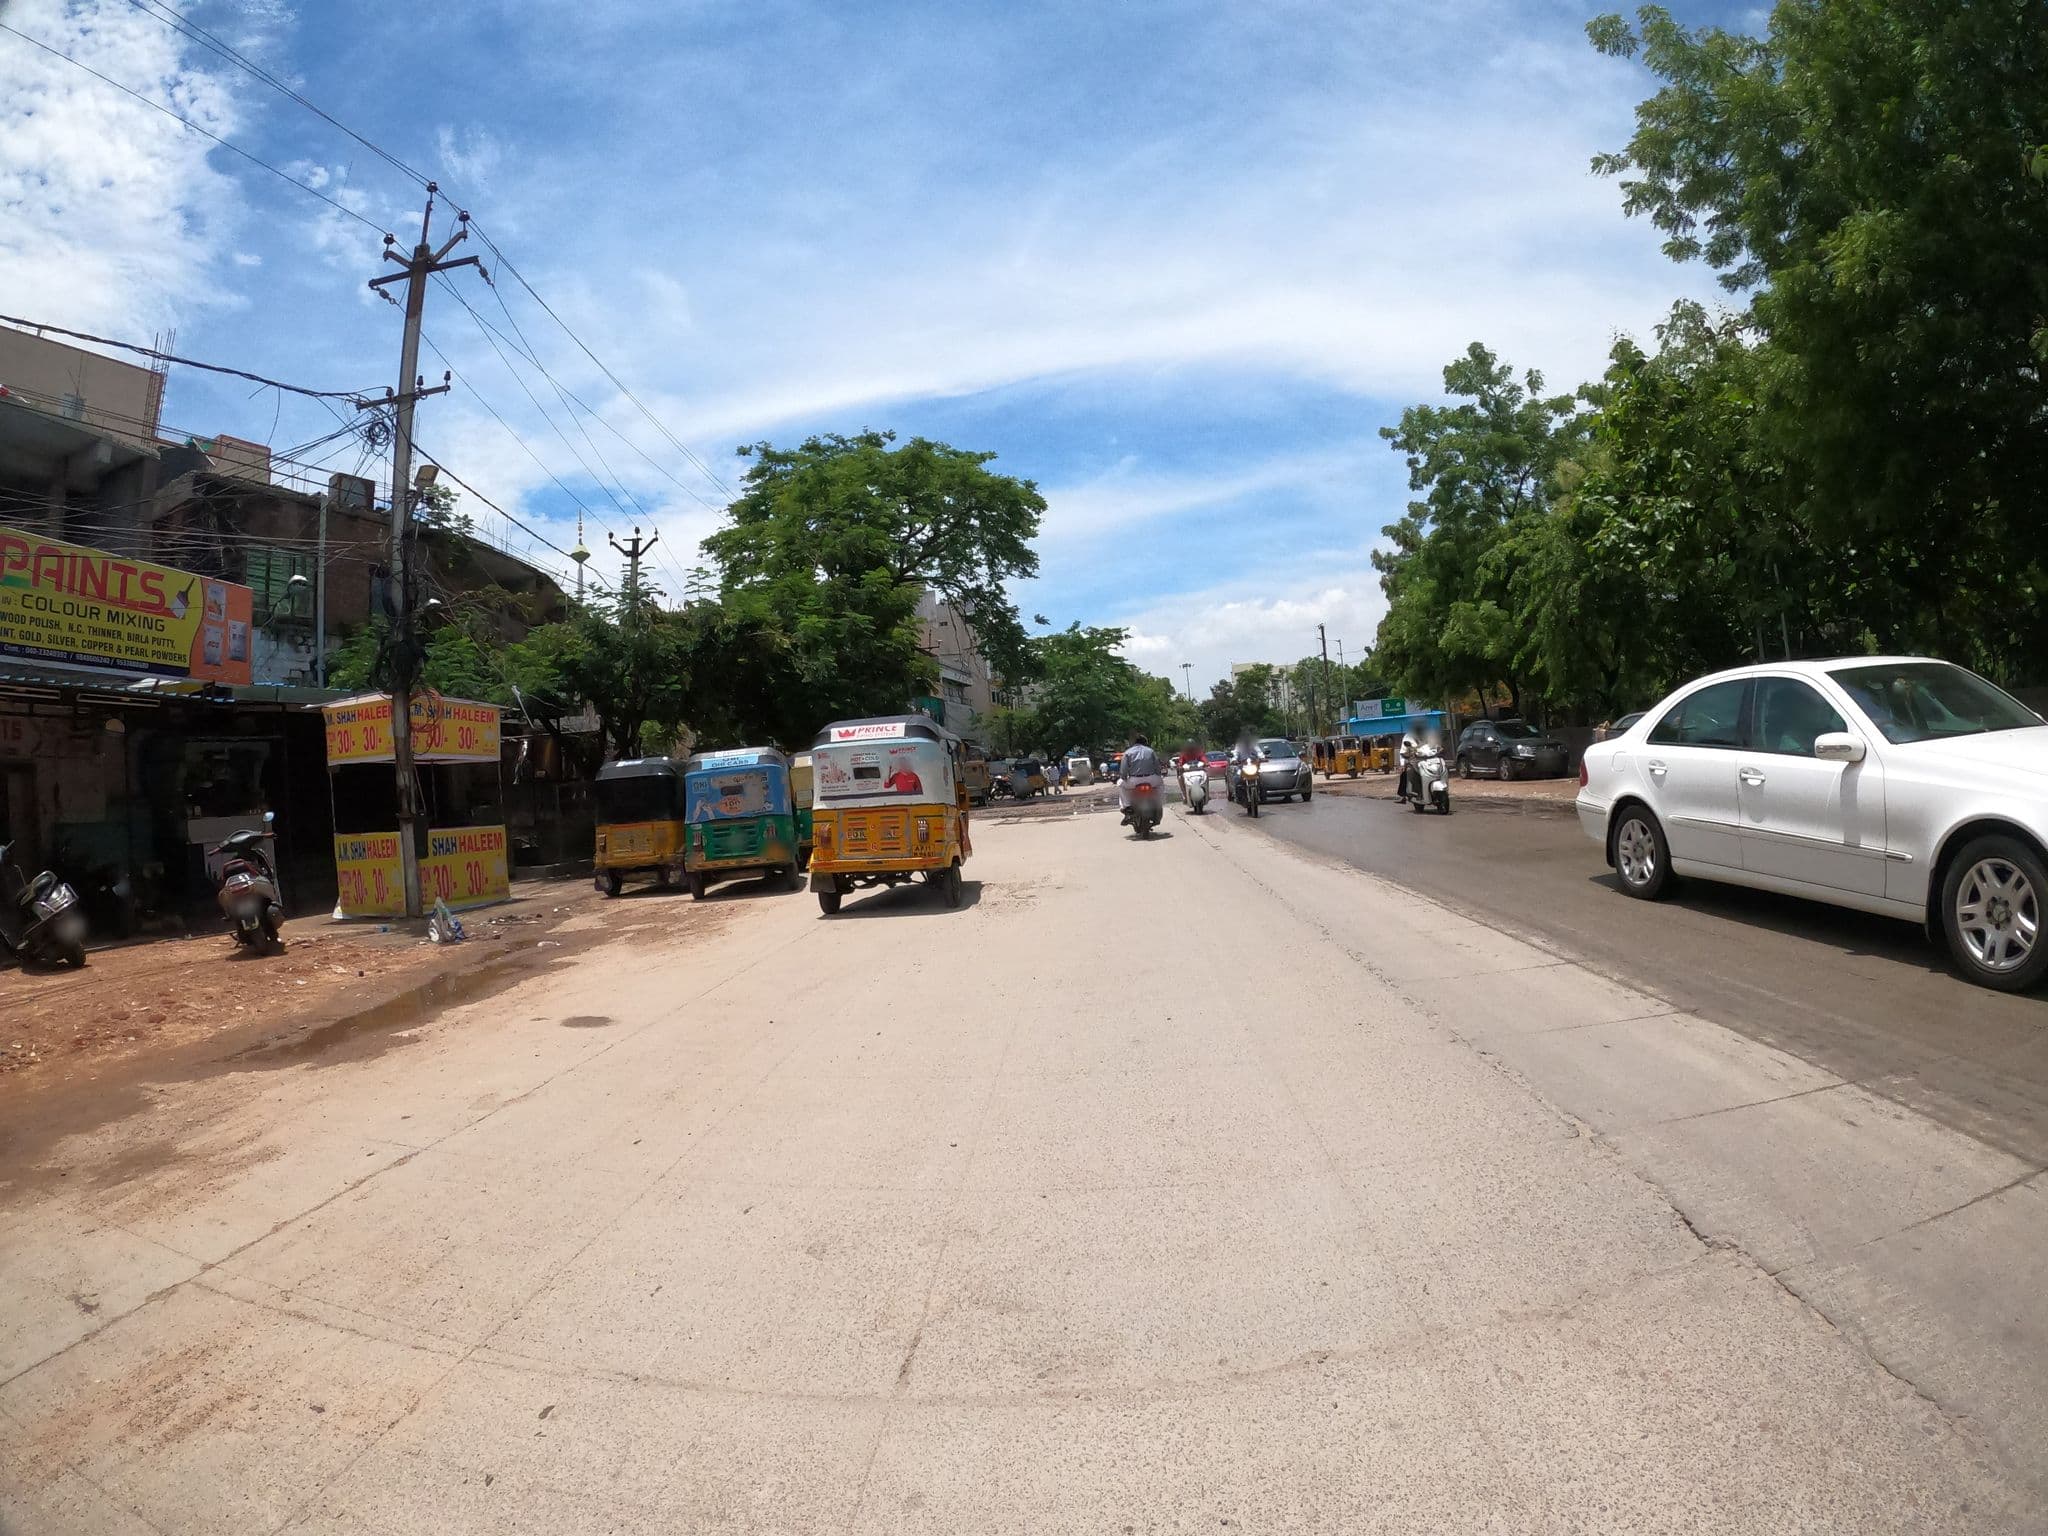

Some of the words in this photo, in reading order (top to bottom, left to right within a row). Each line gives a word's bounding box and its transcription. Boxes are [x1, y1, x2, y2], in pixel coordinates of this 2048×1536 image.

[0, 533, 166, 613] PAINTS
[22, 594, 101, 621] COLOUR
[107, 609, 165, 632] MIXING
[127, 632, 149, 645] BIRLA
[81, 638, 114, 654] COPPER
[116, 644, 122, 654] &
[125, 645, 149, 658] PEARL
[151, 649, 187, 664] POWDERS
[336, 709, 357, 725] SHAH
[454, 705, 494, 723] HALEEM
[367, 838, 397, 858] HALEEM
[432, 836, 457, 856] SHAH
[459, 832, 502, 853] HALEEM
